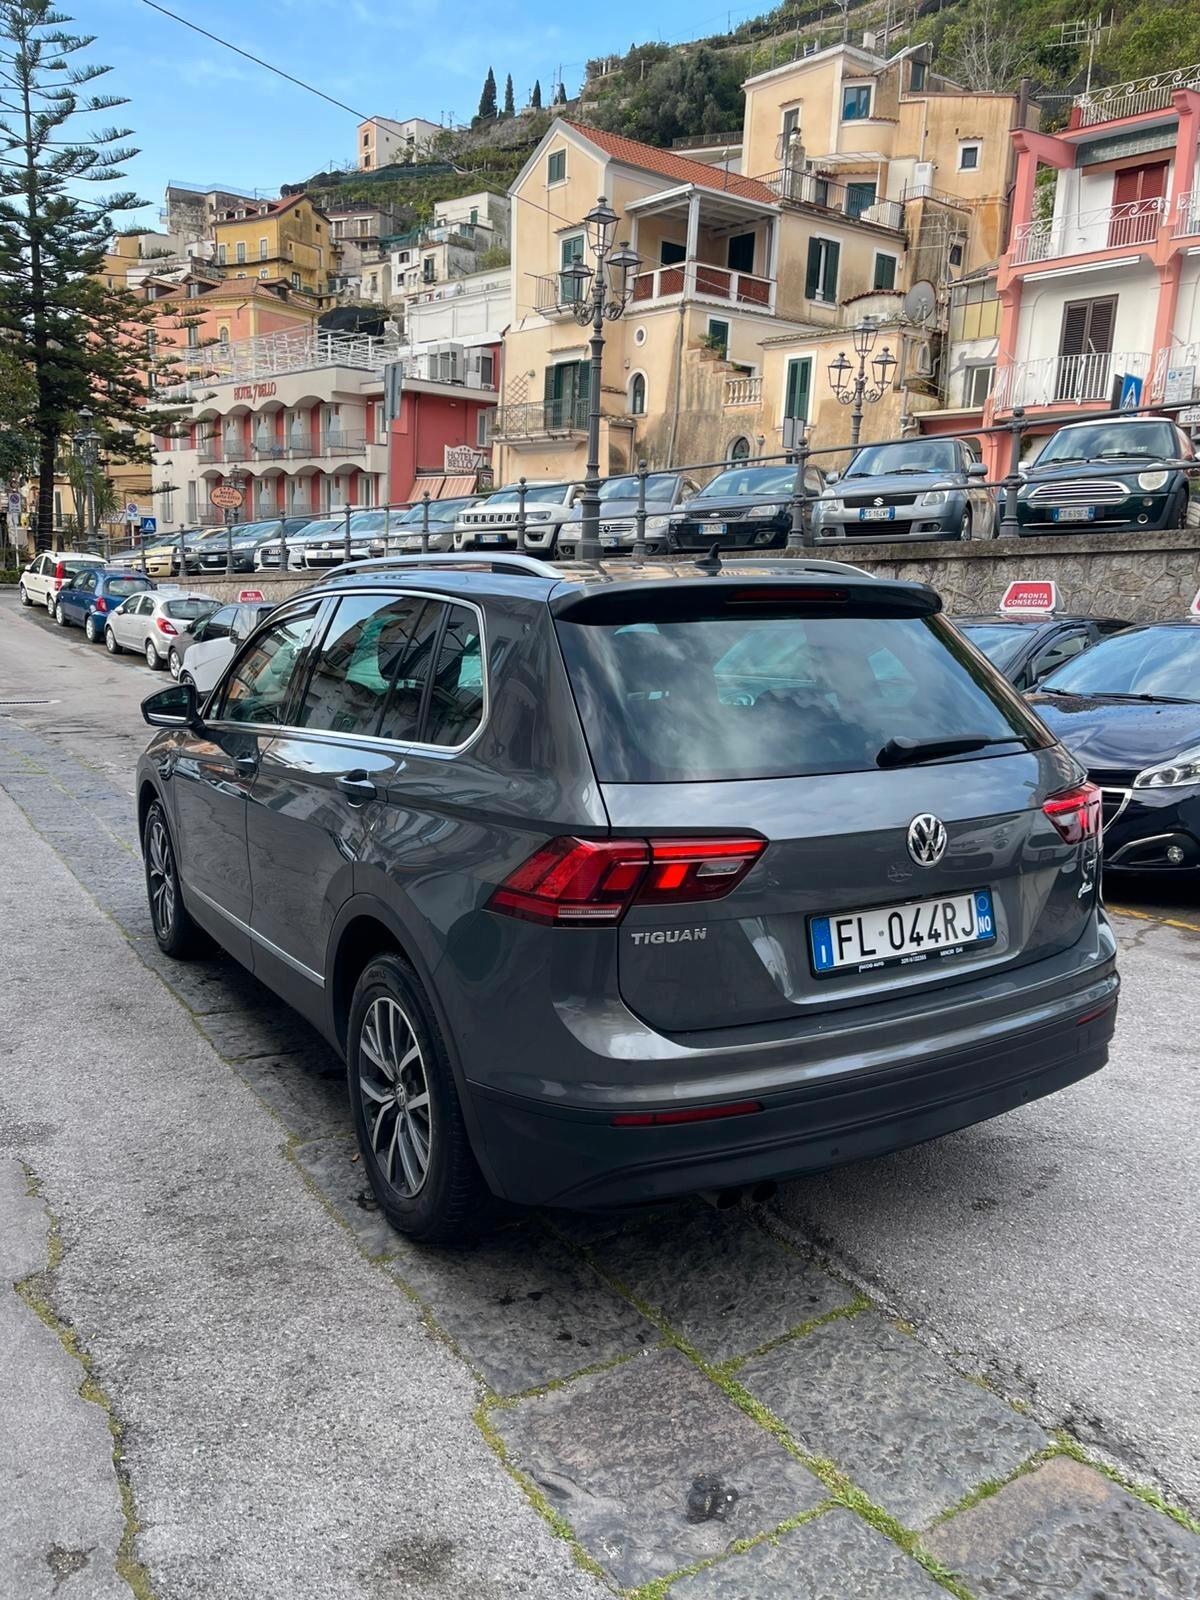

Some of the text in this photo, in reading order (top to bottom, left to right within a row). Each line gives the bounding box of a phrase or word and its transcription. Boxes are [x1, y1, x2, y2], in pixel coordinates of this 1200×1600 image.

[233, 385, 252, 400] HOTEL
[447, 450, 473, 461] HOTEL
[447, 459, 474, 469] BELLO
[472, 452, 482, 471] 7
[888, 898, 975, 950] 044RJ
[978, 915, 991, 933] NO
[631, 927, 707, 945] TIGUAN
